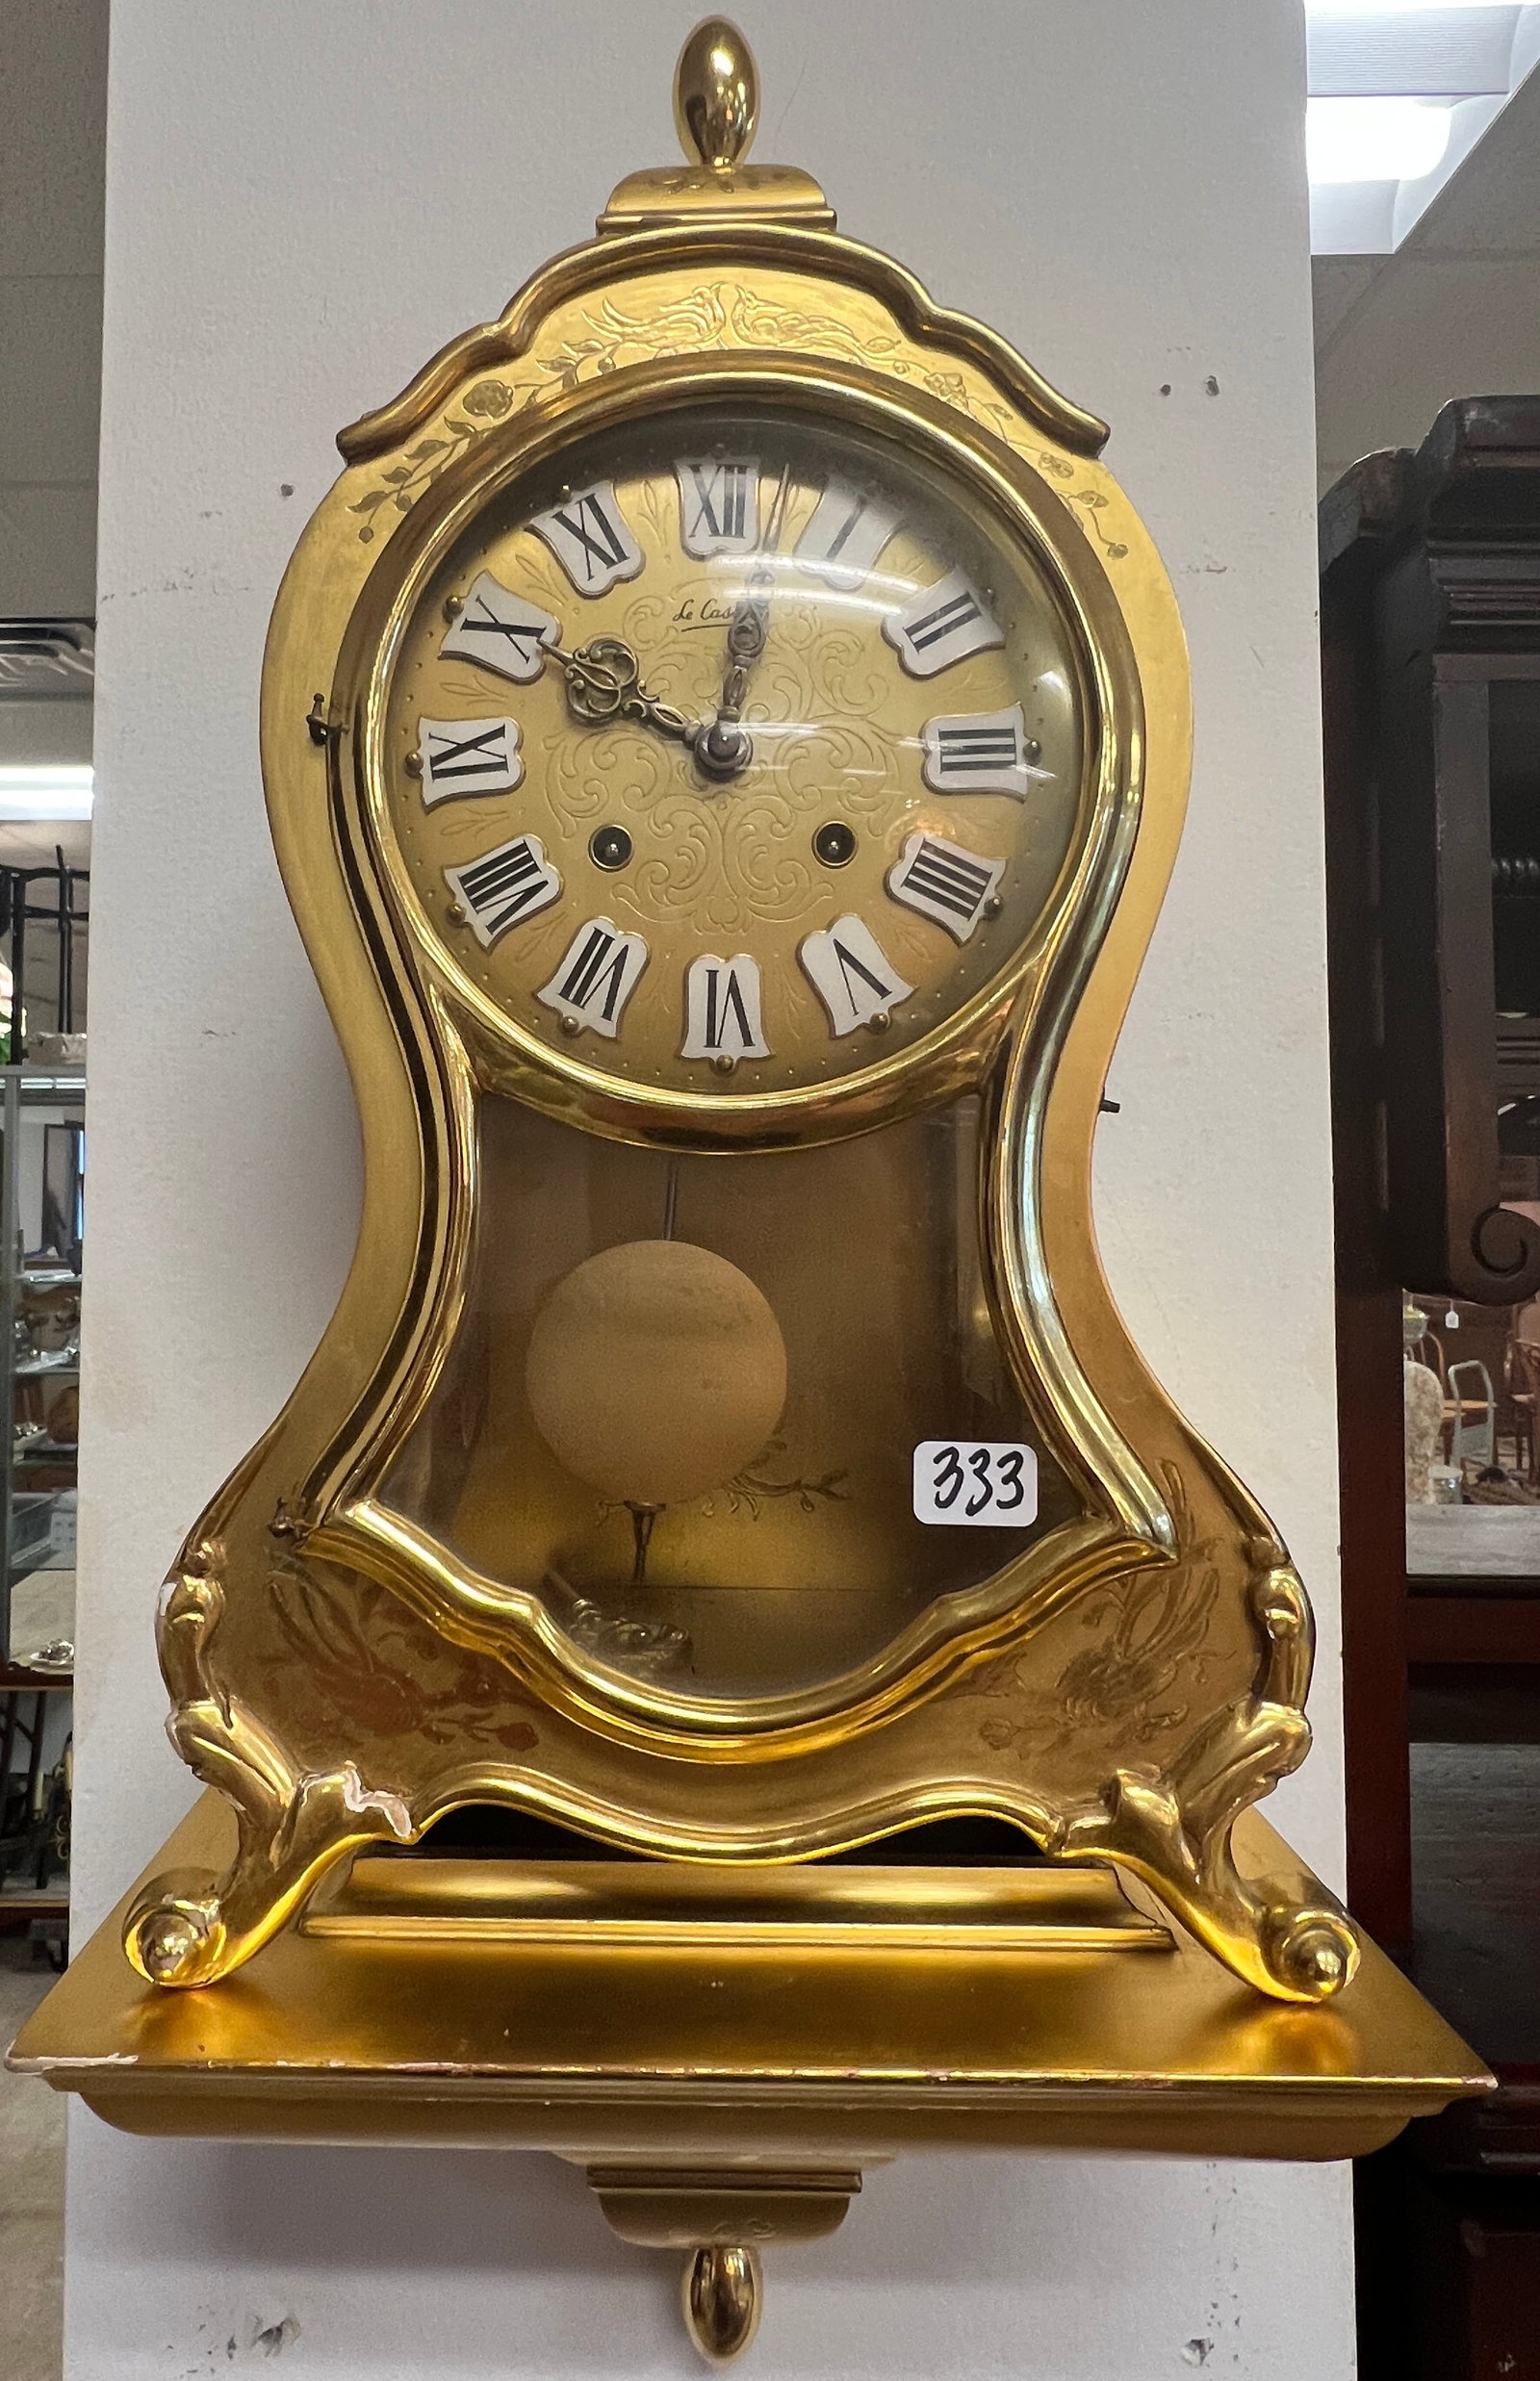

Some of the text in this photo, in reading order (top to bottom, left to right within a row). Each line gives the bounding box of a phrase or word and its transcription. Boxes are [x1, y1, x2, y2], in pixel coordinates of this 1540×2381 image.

[552, 492, 630, 579] XI
[687, 464, 749, 539] XII
[825, 493, 870, 561] I
[461, 596, 547, 662] X
[672, 597, 737, 622] Le Cas
[903, 590, 983, 654] II
[427, 725, 509, 781] IX
[937, 728, 1017, 773] III
[457, 839, 550, 935] VIII
[901, 837, 994, 921] IIII
[558, 926, 629, 1022] VII
[704, 968, 755, 1049] VI
[833, 937, 892, 1016] V
[933, 1446, 1025, 1517] 333
